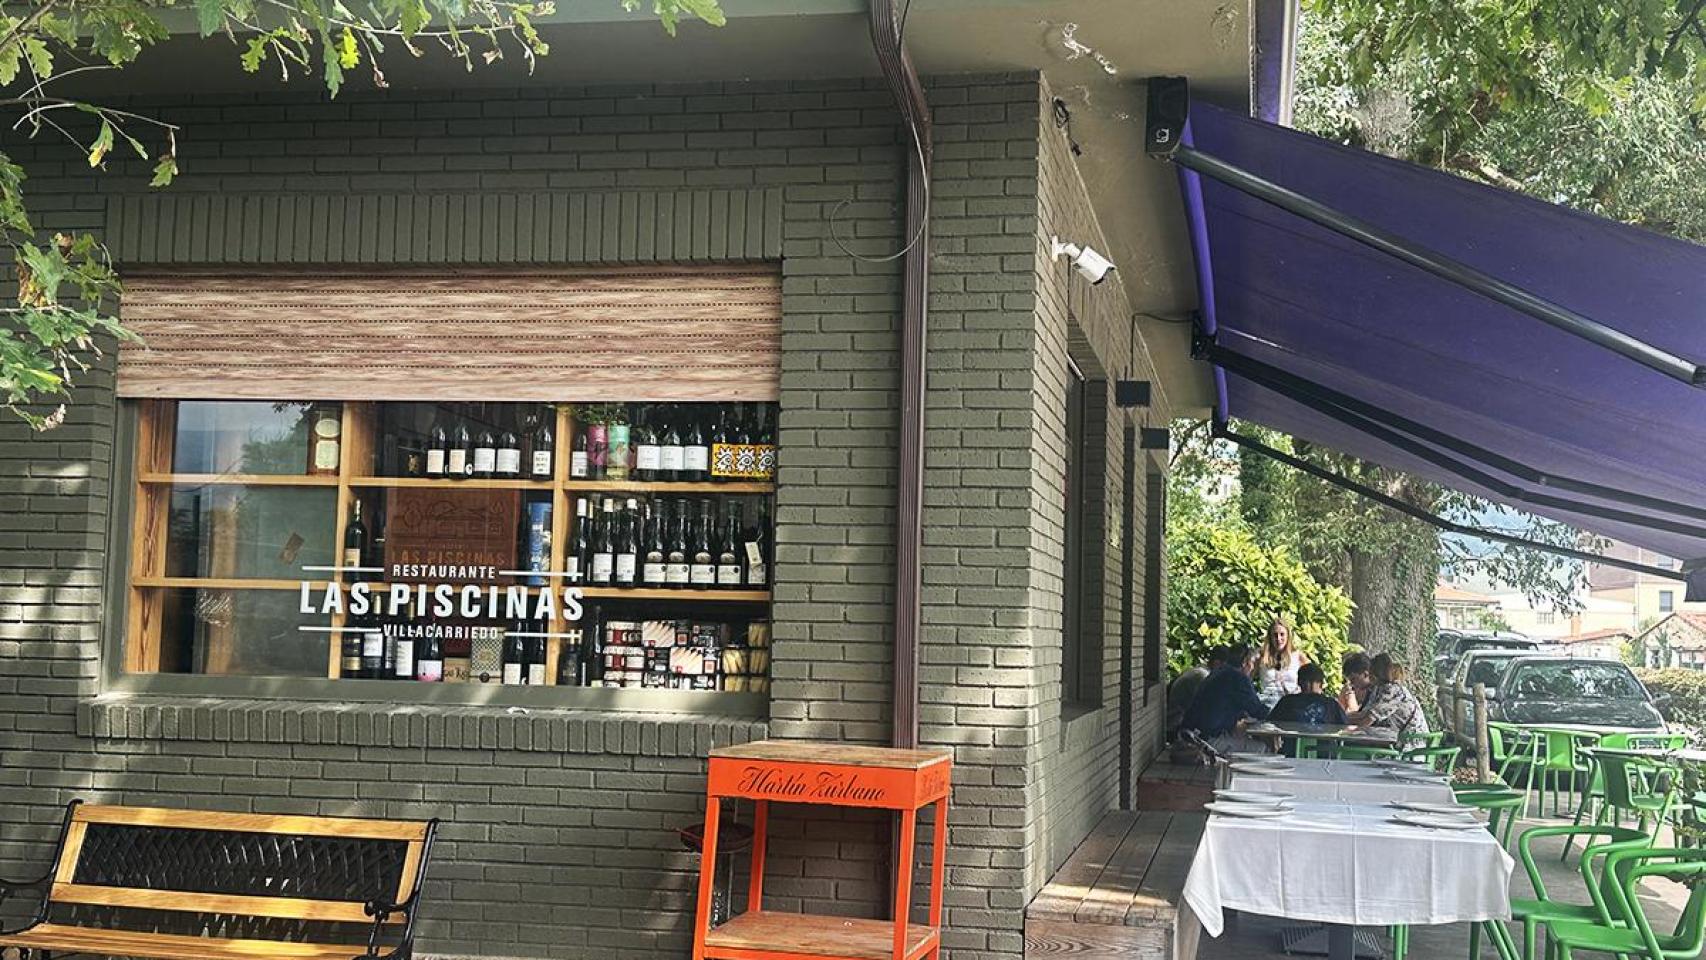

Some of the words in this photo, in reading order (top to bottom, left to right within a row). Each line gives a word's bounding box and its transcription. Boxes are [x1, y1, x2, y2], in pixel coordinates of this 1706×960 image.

[393, 564, 496, 579] RESTAURANTE
[300, 581, 370, 616] LAS
[389, 583, 584, 621] PISCINAS
[383, 623, 498, 640] VILLACARRIEDO
[737, 766, 807, 796] Martín
[810, 771, 886, 801] Zurbano
